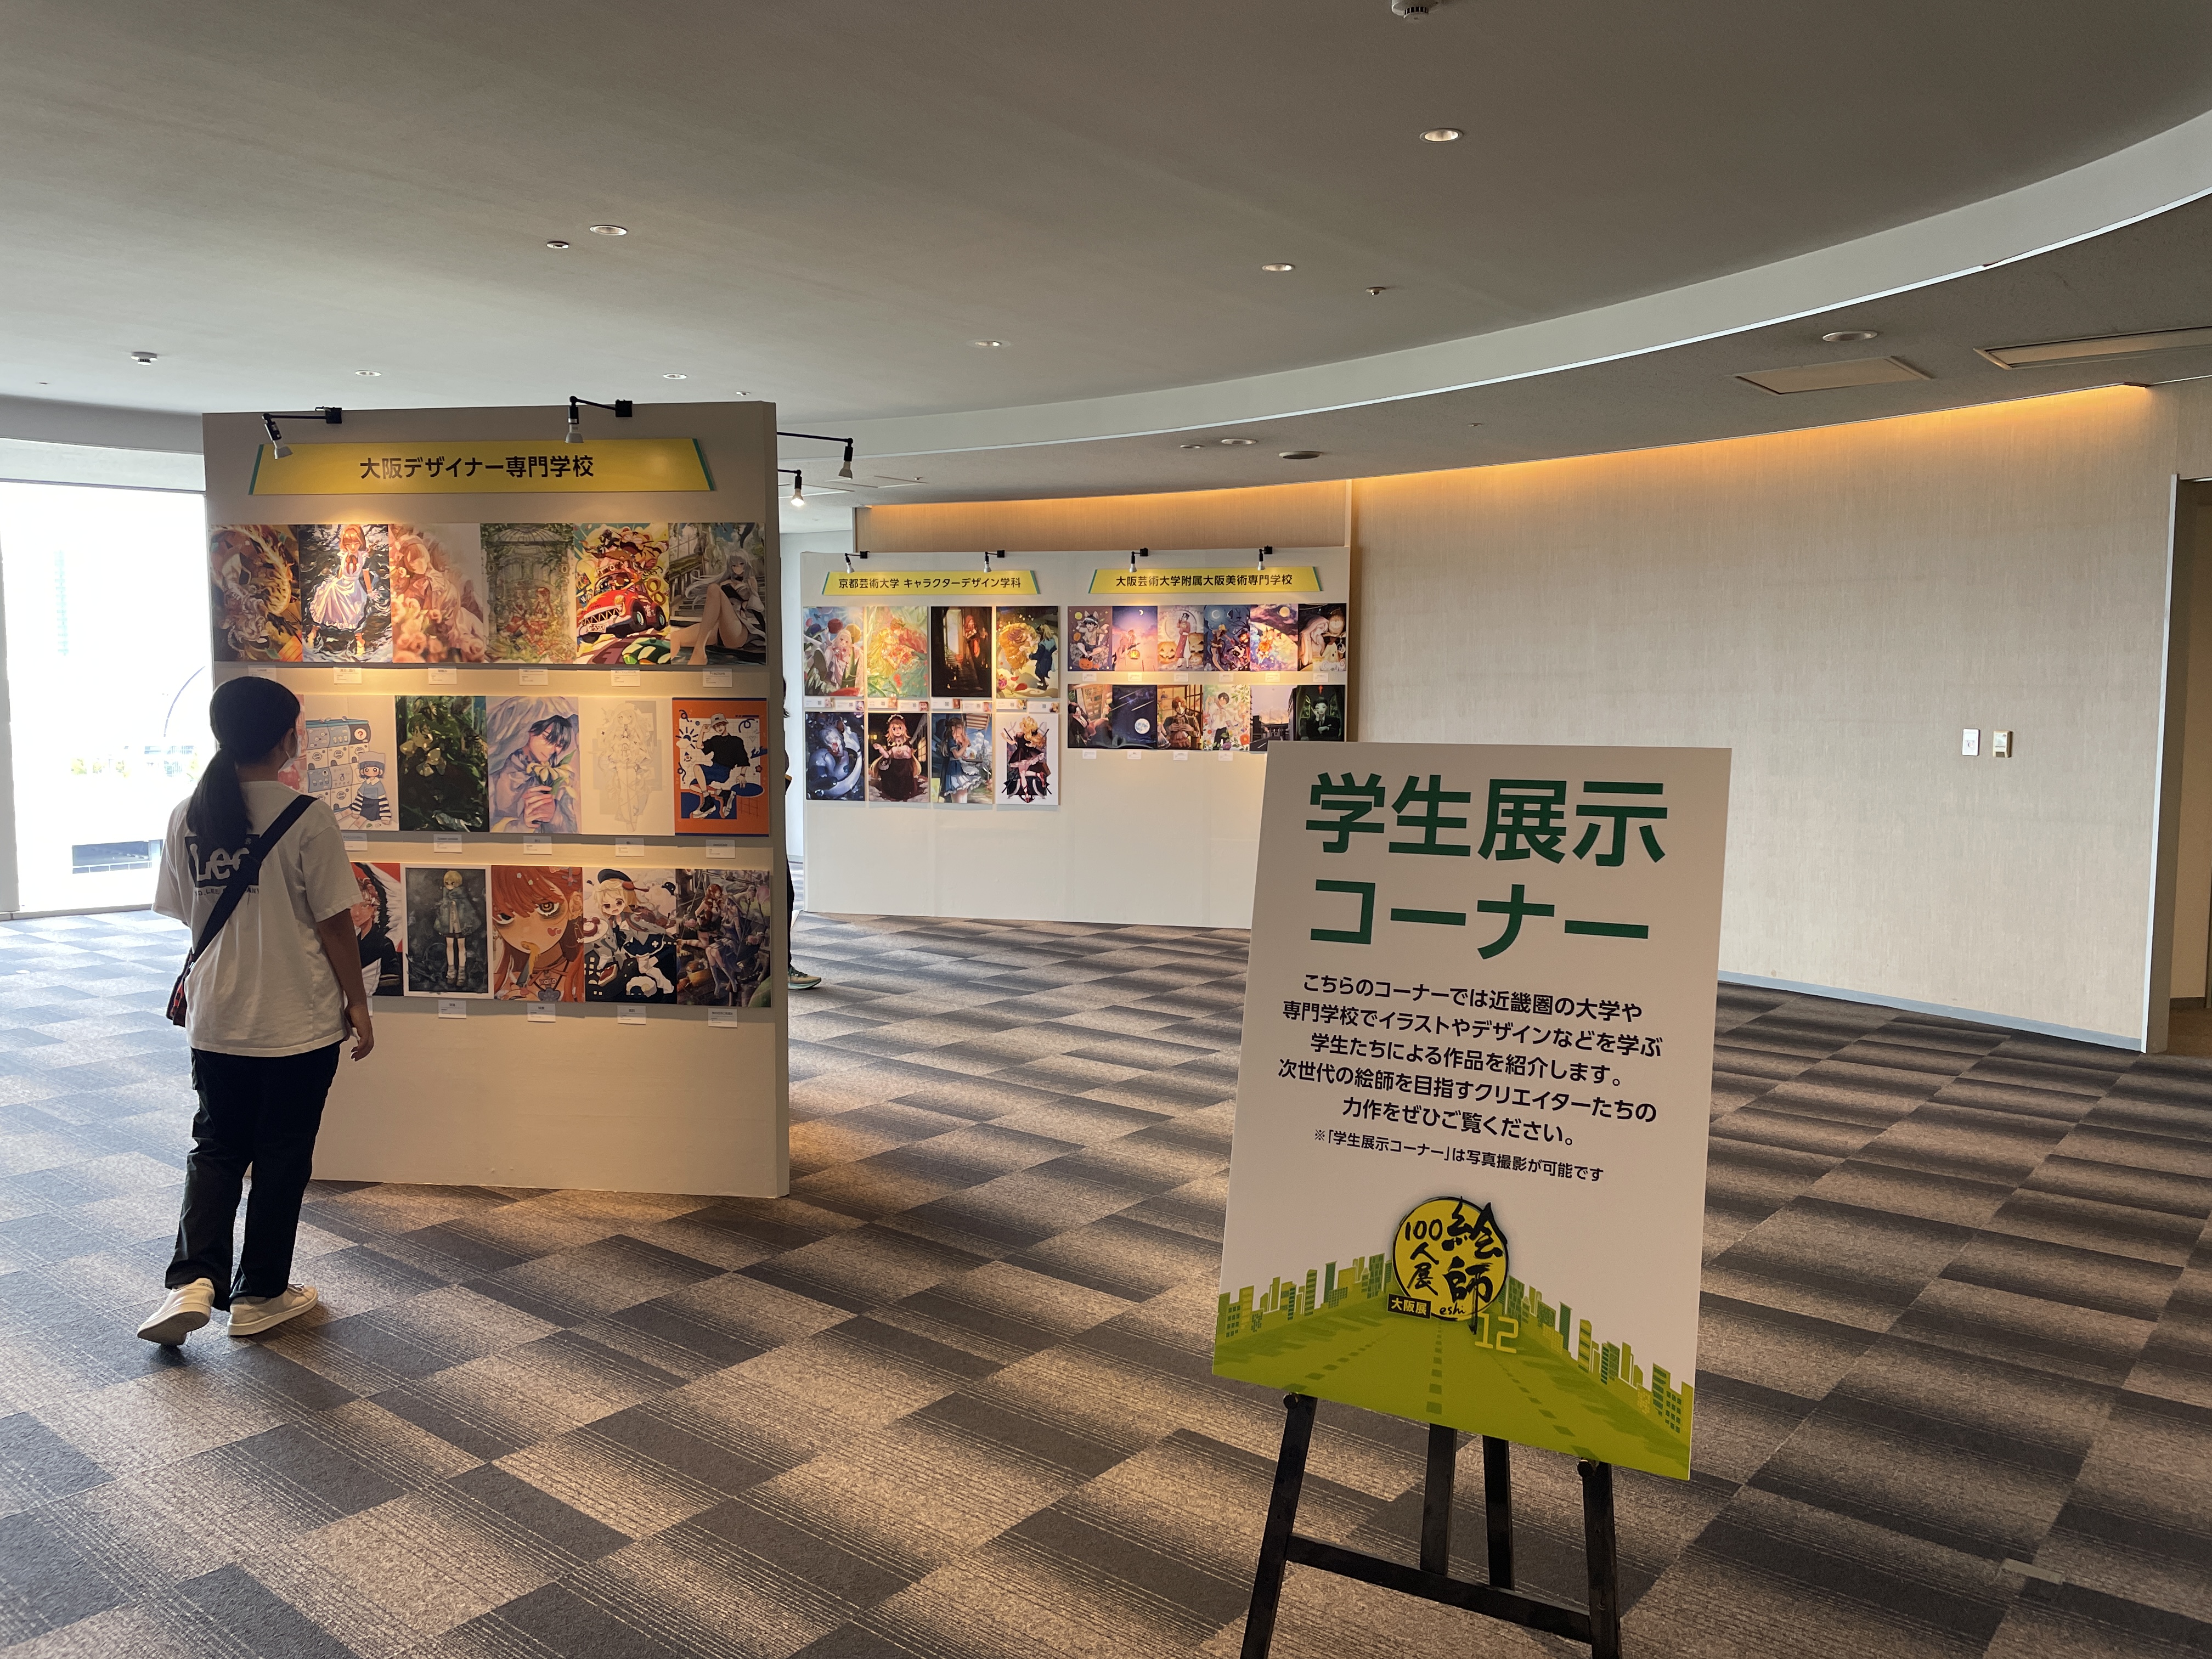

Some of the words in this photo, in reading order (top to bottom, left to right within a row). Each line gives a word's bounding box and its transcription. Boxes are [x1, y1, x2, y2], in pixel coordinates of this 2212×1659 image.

[359, 455, 594, 480] 大阪デザイナー専門学校
[838, 578, 900, 589] 京都芸術大学
[904, 577, 1021, 589] キャラクターデザイン学科
[1115, 574, 1293, 586] 大阪芸術大学附属大阪美術専門学校
[1306, 772, 1668, 867] 学生展示
[1310, 879, 1649, 960] コーナー
[1303, 974, 1643, 1023] こちらのコーナーでは近畿圏の大学や
[1282, 1000, 1663, 1057] 専門学校でイラストやデザインなどを学ぶ
[1310, 1032, 1621, 1086] 学生たちによる作品を紹介します。
[1278, 1058, 1657, 1123] 次世代の絵師を目指すクリエイターたちの
[1342, 1097, 1573, 1146] 力作をぜひご覧ください。
[1390, 1297, 1427, 1317] 大阪展
[1439, 1302, 1466, 1316] eshi
[1474, 1312, 1519, 1353] 12
